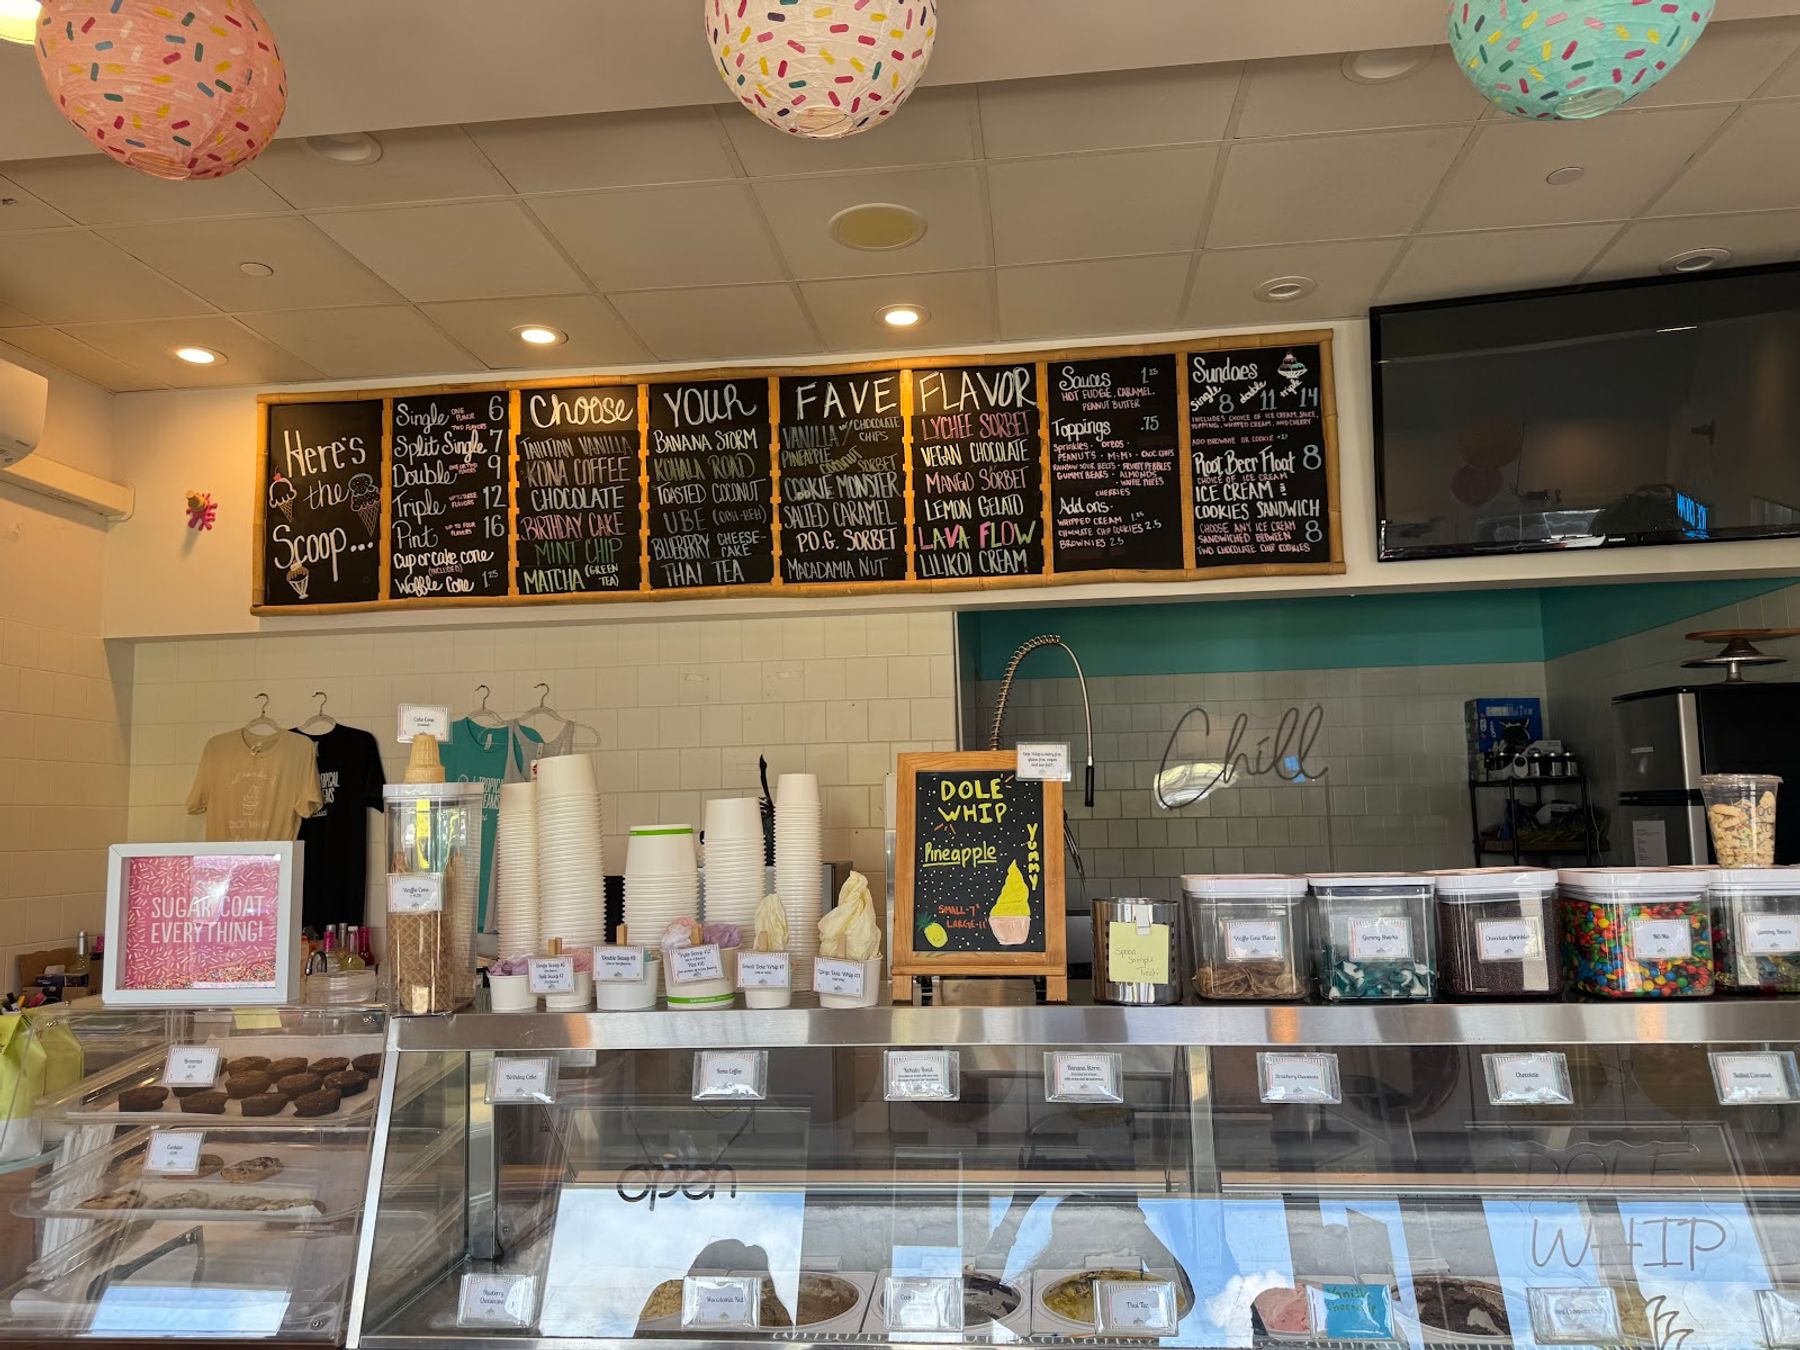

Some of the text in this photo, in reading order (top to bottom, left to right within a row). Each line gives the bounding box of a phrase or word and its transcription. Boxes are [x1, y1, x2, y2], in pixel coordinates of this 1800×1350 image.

[1059, 366, 1111, 391] Sauces
[1192, 357, 1258, 383] Sundaes
[530, 366, 1037, 429] Choose YOUR FAVE FLAVOR
[1061, 390, 1079, 401] HOT
[1082, 399, 1141, 411] PEANUT BUTTER
[1219, 387, 1319, 414] 8 11 14
[396, 395, 504, 434] Single 6
[922, 409, 1031, 441] LYCHEE SORBET
[653, 428, 758, 454] BANANA STORM
[782, 416, 901, 449] VANILLA CHOCOLATE
[859, 430, 889, 442] CHIPS
[1051, 416, 1159, 442] Toppings .75
[284, 429, 367, 478] Here's
[394, 429, 503, 465] Split Single 7
[520, 436, 633, 460] TAHITIAN VANILLA
[781, 444, 898, 475] PINEAPPLE COCONUT SORBET
[921, 439, 1029, 467] VEGAN CHOCOLATE
[1057, 451, 1096, 462] PEANUTS
[1192, 444, 1322, 477] Root Beer Float 8
[392, 455, 501, 487] Double 9
[526, 456, 631, 488] KONA COFFEE
[653, 452, 756, 481] KOHALA ROAD
[1057, 470, 1157, 480] GUMMY BEARS ALMONDS
[1144, 461, 1172, 471] PEBBLES
[1197, 472, 1288, 485] CHOICE OF ICE CREAM
[655, 479, 767, 506] TOASTED COCONUT
[784, 471, 902, 501] COOKIE MONSTER
[925, 466, 1029, 494] MANGO SORBET
[1095, 488, 1130, 496] CHERRIES
[1195, 484, 1220, 502] ICE
[1223, 480, 1274, 501] CREAM
[303, 480, 353, 510] the
[392, 485, 507, 525] Triple 12
[531, 485, 625, 512] CHOCOLATE
[925, 494, 1024, 521] LEMON GELATO
[1059, 497, 1085, 515] Add
[663, 508, 707, 535] UBE
[784, 498, 898, 529] SALTED CARAMEL
[1057, 516, 1122, 526] WHIPPED CREAM
[1195, 499, 1320, 520] COOKIES SANDWICH
[392, 514, 505, 549] Pint 16
[520, 512, 626, 540] BIRTHDAY CAKE
[844, 527, 898, 551] SORBET
[919, 521, 1036, 551] LAVA FLOW
[1057, 519, 1162, 537] CHOCOLATE CHIP COOKIES 2.5
[1197, 531, 1292, 544] SANDWICHED BETWEEN
[1200, 520, 1323, 542] CHOOSE ANY ICE CREAM 8
[534, 538, 623, 566] MINT CHIP
[651, 533, 710, 561] BLUEBERRY
[721, 543, 752, 558] CAKE
[1059, 536, 1124, 550] BROWNIES 2.5
[1197, 542, 1311, 555] TWO CHOCOLATE CHIP COOKIES
[460, 550, 494, 564] cone
[787, 556, 889, 580] MACADAMIA NUT
[920, 548, 1028, 577] LILIKOI CREAM
[394, 574, 443, 597] Waffle
[523, 563, 619, 594] MATCHA (GREEN
[599, 574, 620, 587] TEA)
[661, 559, 745, 587] THAI TEA
[1158, 705, 1328, 809] Chill
[942, 779, 1004, 802] DOLE
[938, 803, 1007, 824] WHIP
[924, 841, 997, 868] Pineapple
[151, 896, 266, 919] SUGAR COAT
[151, 921, 263, 944] EVERYTHING!
[616, 1164, 737, 1212] open
[1532, 1217, 1726, 1271] WHIP
